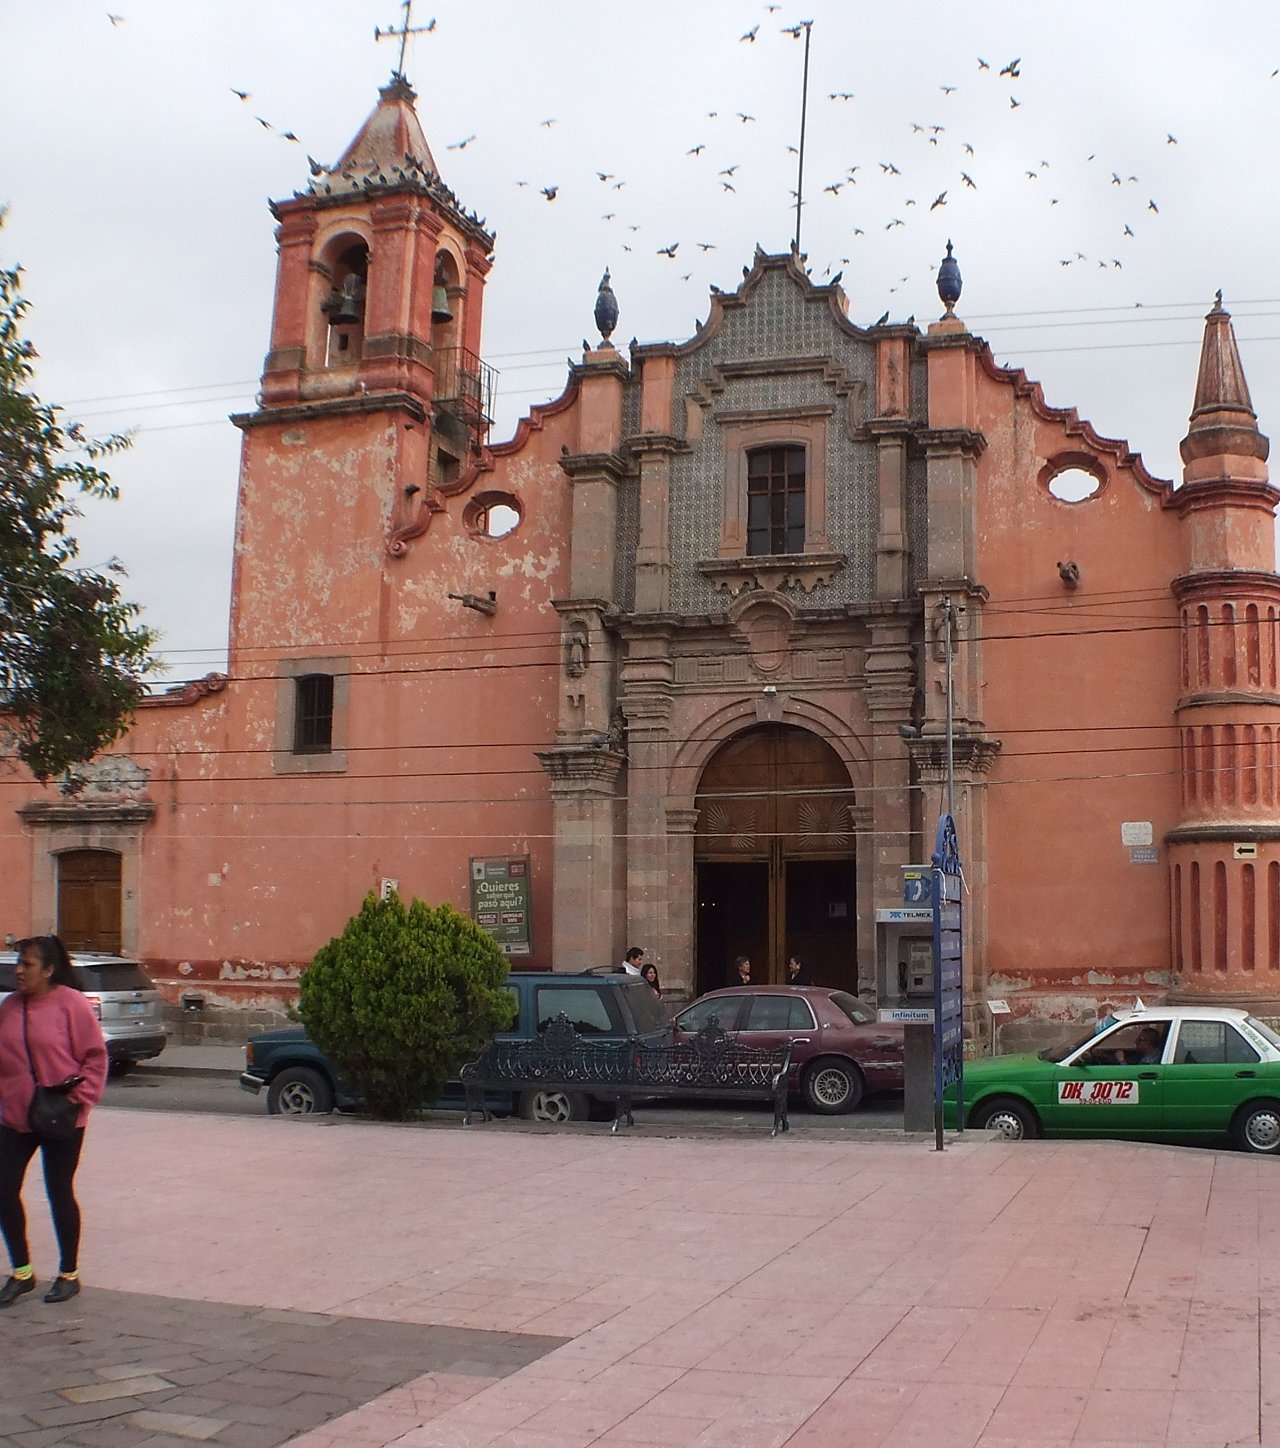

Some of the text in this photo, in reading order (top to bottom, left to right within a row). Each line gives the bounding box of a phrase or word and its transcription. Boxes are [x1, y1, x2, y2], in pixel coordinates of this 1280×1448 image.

[476, 881, 519, 894] ¿Quieres
[486, 892, 502, 900] saber
[478, 897, 523, 910] pasó aquí?
